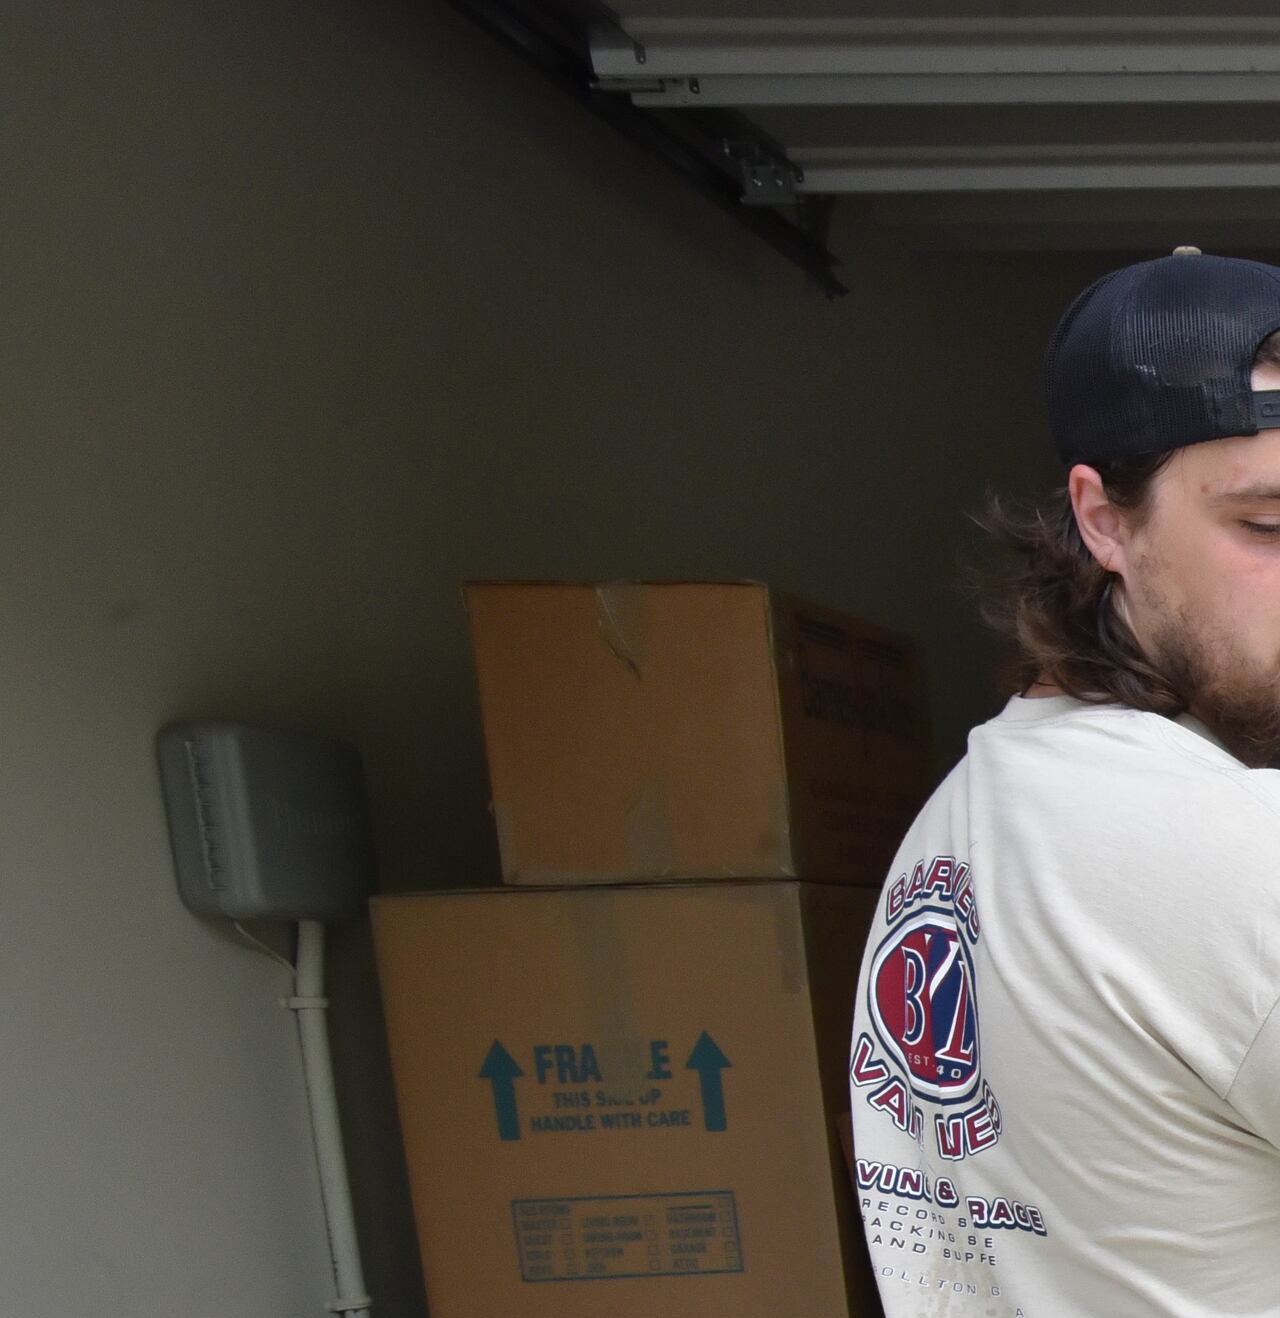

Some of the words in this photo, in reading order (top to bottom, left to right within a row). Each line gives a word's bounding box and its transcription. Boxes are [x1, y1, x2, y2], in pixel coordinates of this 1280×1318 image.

[533, 1040, 673, 1085] FRAE
[552, 1092, 591, 1109] THIS
[531, 1114, 596, 1133] HANDLE
[600, 1112, 642, 1130] WITH
[647, 1109, 691, 1127] CARE
[935, 1176, 960, 1208] &
[966, 1196, 1048, 1237] RAGE
[872, 1234, 927, 1256] AND
[873, 1265, 978, 1296] OLLTON
